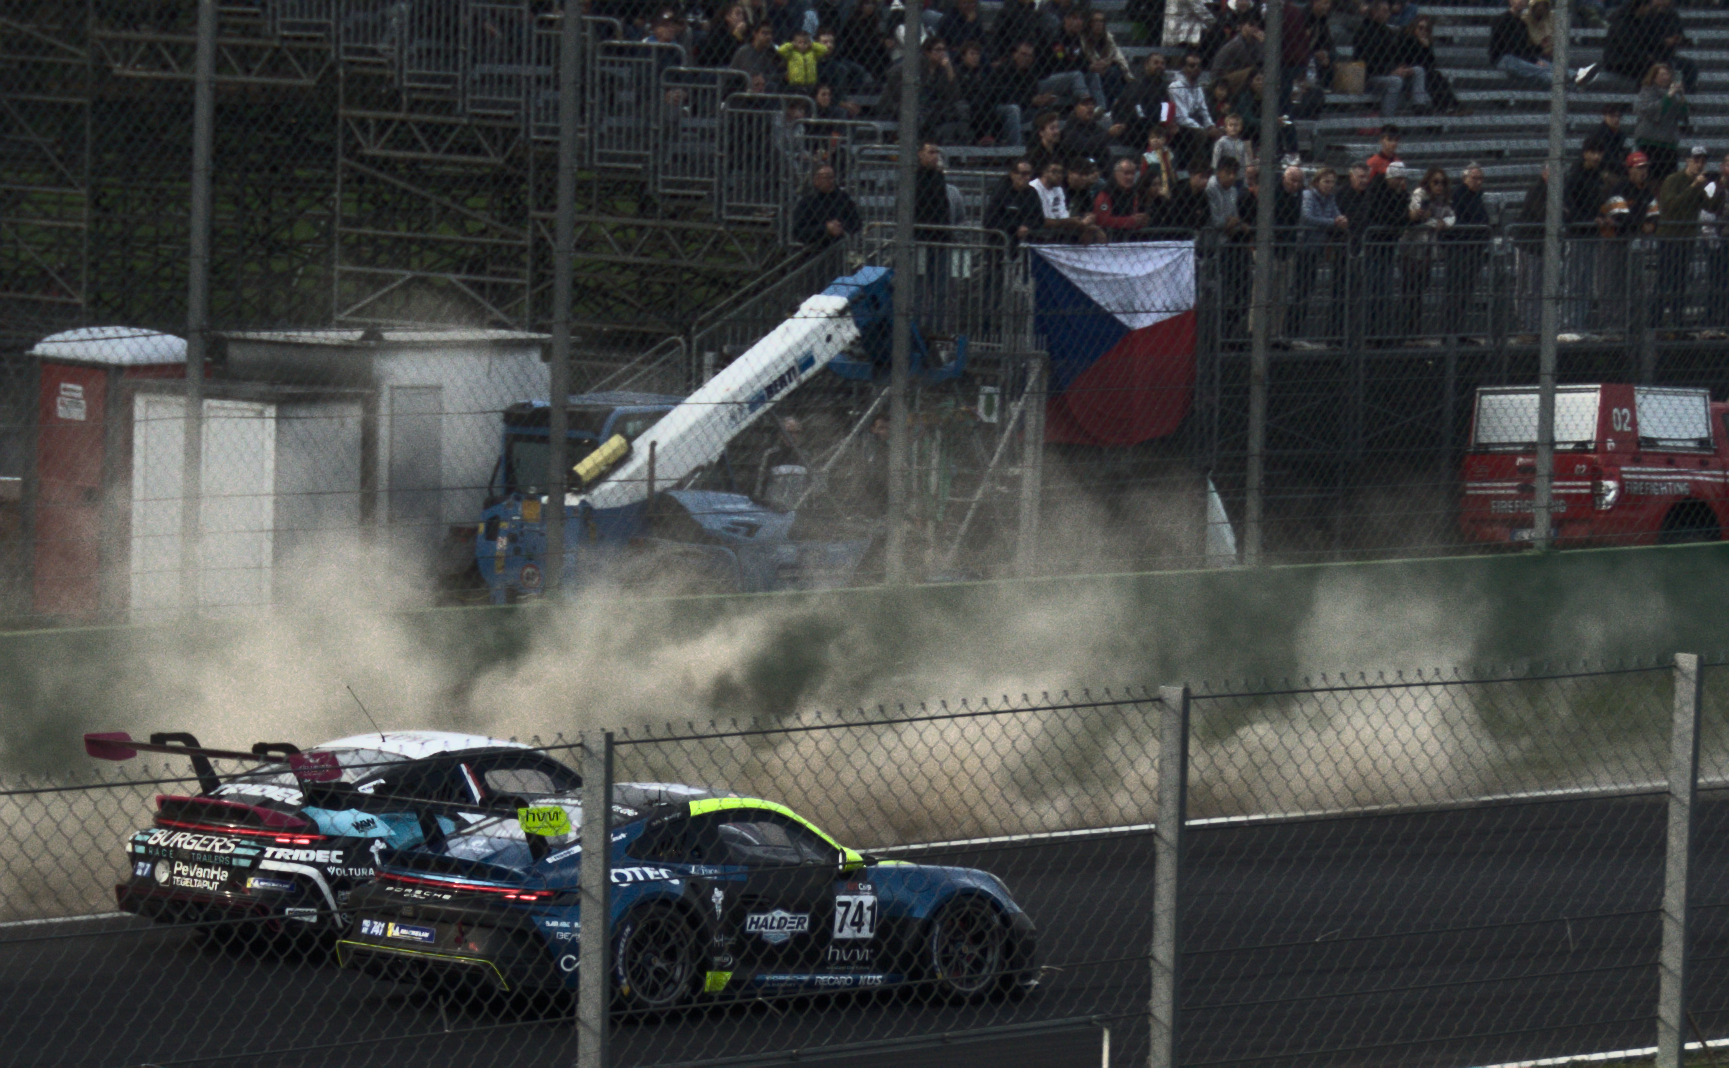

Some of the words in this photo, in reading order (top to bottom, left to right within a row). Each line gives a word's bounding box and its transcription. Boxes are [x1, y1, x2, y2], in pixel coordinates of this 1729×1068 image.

[1612, 407, 1632, 432] 02
[1624, 481, 1690, 496] FIREFIGHTING
[147, 828, 242, 855] BURGERS
[148, 848, 175, 859] RACE
[190, 852, 231, 866] TRAILERS
[263, 846, 344, 864] TRIDEC
[173, 860, 230, 882] PeVanHa
[747, 916, 808, 930] HALDER
[836, 900, 877, 934] 741
[814, 975, 854, 987] RECARO
